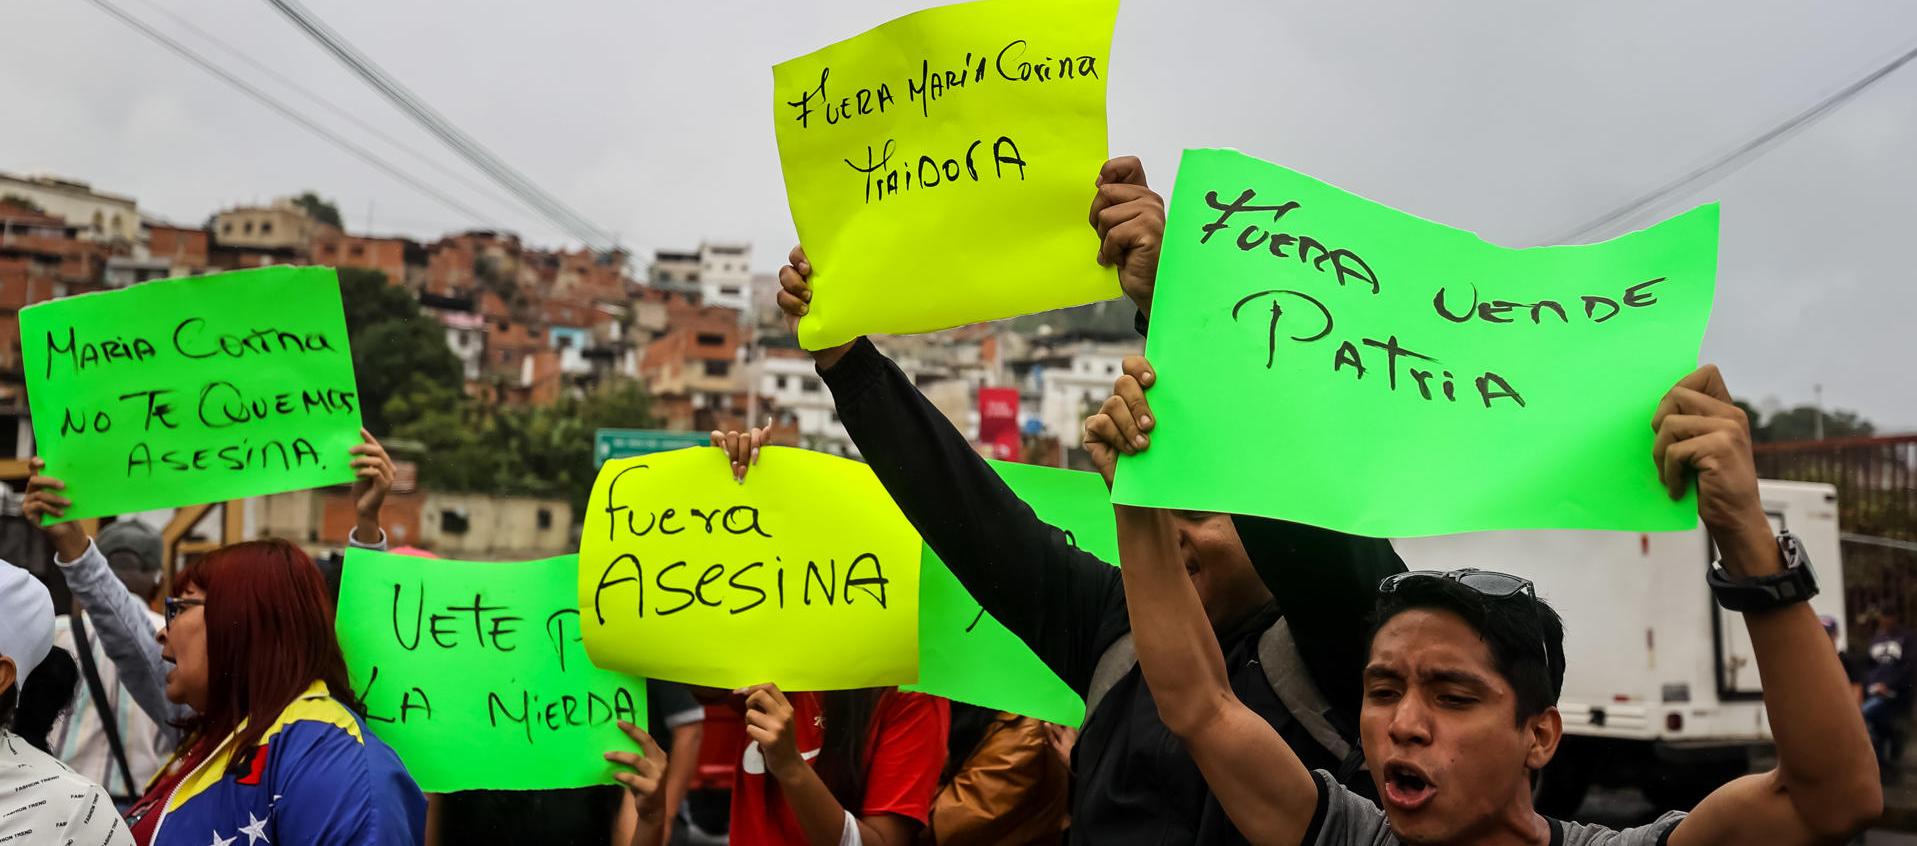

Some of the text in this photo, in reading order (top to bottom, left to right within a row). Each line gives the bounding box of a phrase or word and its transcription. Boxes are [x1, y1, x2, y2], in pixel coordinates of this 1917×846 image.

[787, 67, 894, 128] FUERA
[996, 39, 1099, 83] Corina
[1200, 189, 1380, 295] FUERA
[61, 408, 112, 437] NO
[119, 390, 178, 431] TE
[356, 666, 431, 723] LA
[28, 800, 47, 809] TREND
[14, 829, 33, 838] TREND
